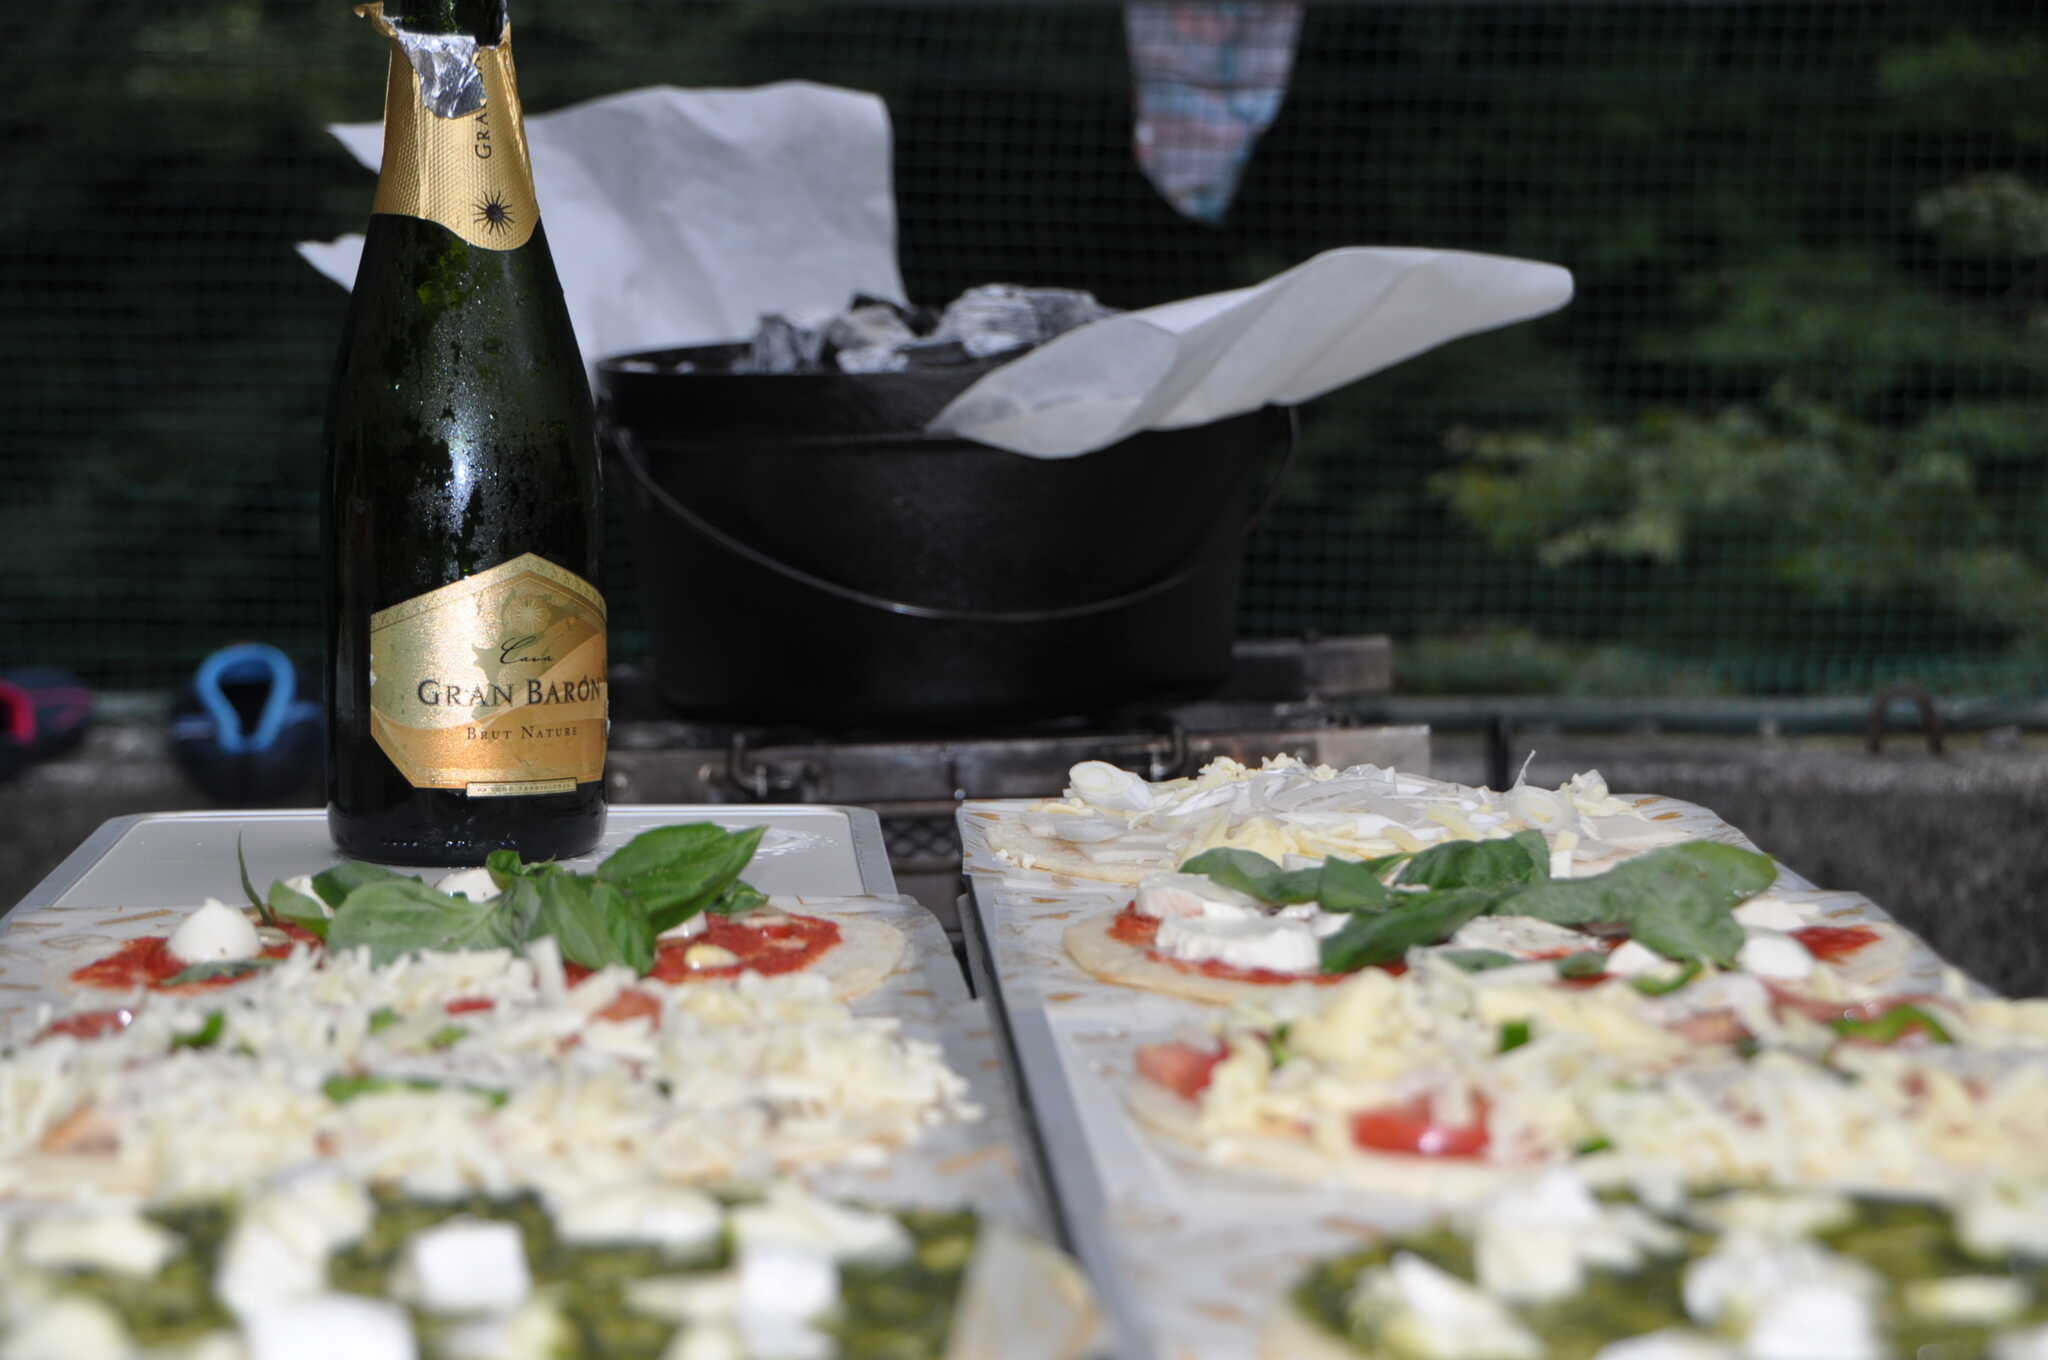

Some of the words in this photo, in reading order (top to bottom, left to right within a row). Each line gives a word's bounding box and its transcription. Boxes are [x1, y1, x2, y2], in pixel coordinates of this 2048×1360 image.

[475, 102, 492, 159] GRA
[500, 635, 555, 665] Cava
[418, 679, 513, 707] GRAN
[527, 675, 601, 705] BARÓN
[467, 727, 512, 740] BRUT
[521, 725, 577, 740] NATURE
